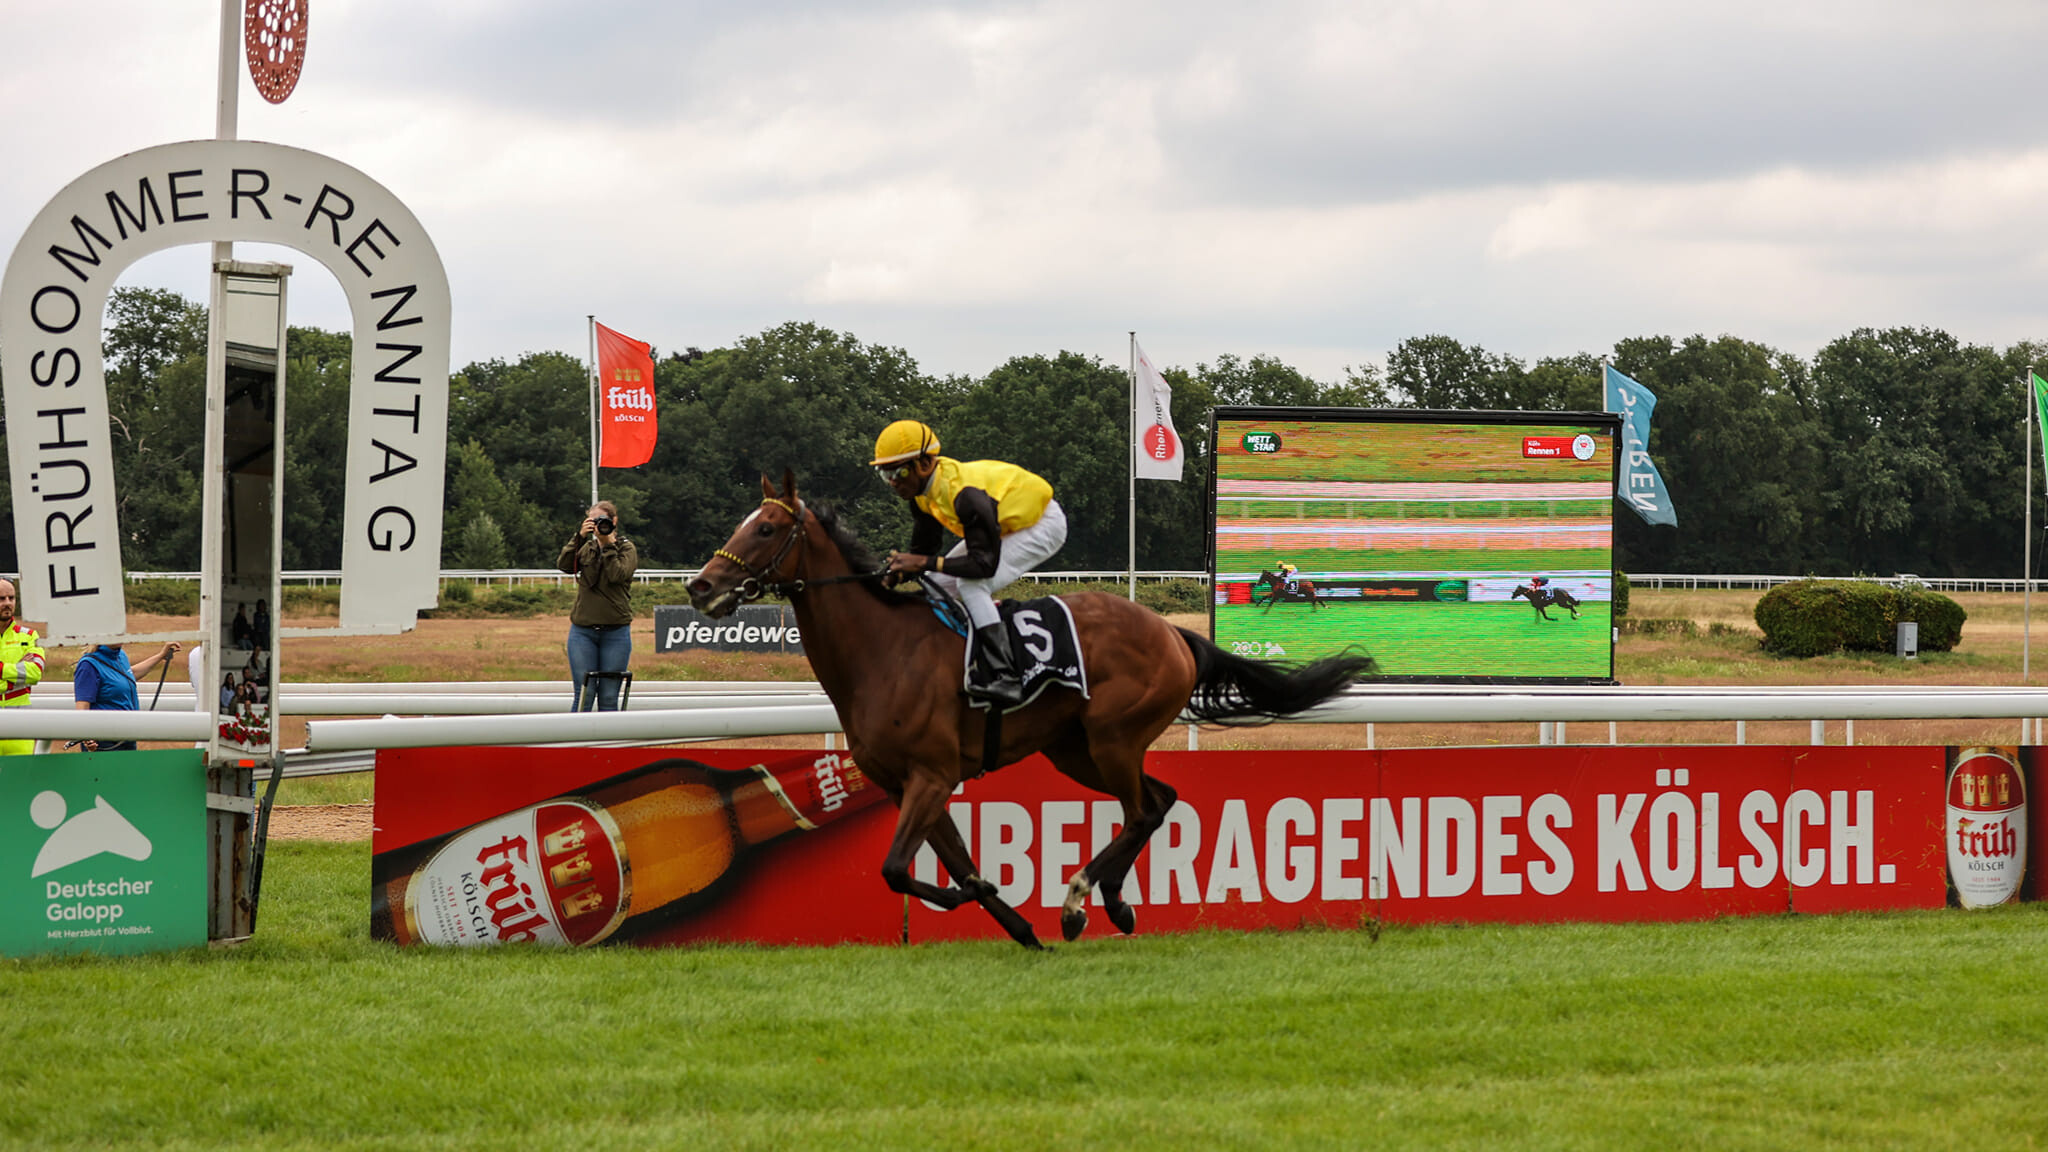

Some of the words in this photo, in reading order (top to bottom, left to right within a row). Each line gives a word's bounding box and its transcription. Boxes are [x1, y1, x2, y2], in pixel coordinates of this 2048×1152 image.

[606, 386, 653, 412] früh
[614, 413, 645, 422] KÖLSCH
[1247, 435, 1272, 443] WETT
[1253, 443, 1276, 452] STAR
[1527, 447, 1554, 455] Rennen
[1013, 609, 1054, 663] 5
[814, 754, 849, 812] früh
[1597, 768, 1896, 892] KÖLSCH.
[1956, 816, 2017, 860] früh
[1968, 860, 2005, 871] KÖLSCH
[46, 877, 153, 899] Deutscher
[446, 886, 458, 909] SEIT
[46, 902, 124, 924] Galopp
[460, 872, 489, 939] KÖLSCH
[47, 930, 62, 939] Mit
[63, 928, 102, 938] Herzblut
[103, 926, 116, 936] für
